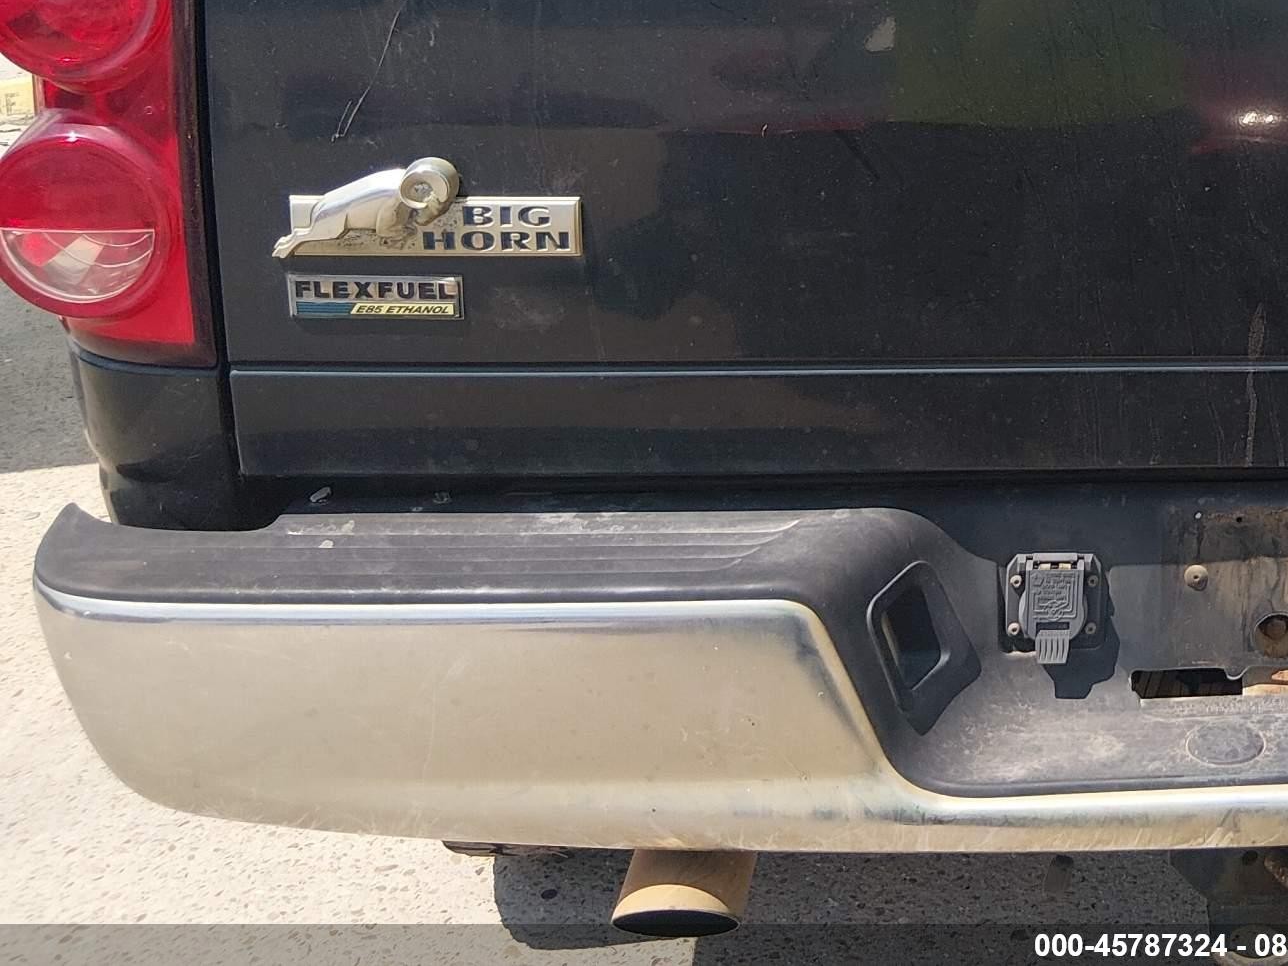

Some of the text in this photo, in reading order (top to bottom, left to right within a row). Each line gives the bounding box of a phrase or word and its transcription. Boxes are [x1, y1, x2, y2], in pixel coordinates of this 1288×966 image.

[462, 205, 553, 228] BIG
[422, 231, 571, 252] HORN
[295, 280, 457, 300] FLEXFUEL
[355, 303, 450, 315] E85 ETHANOL
